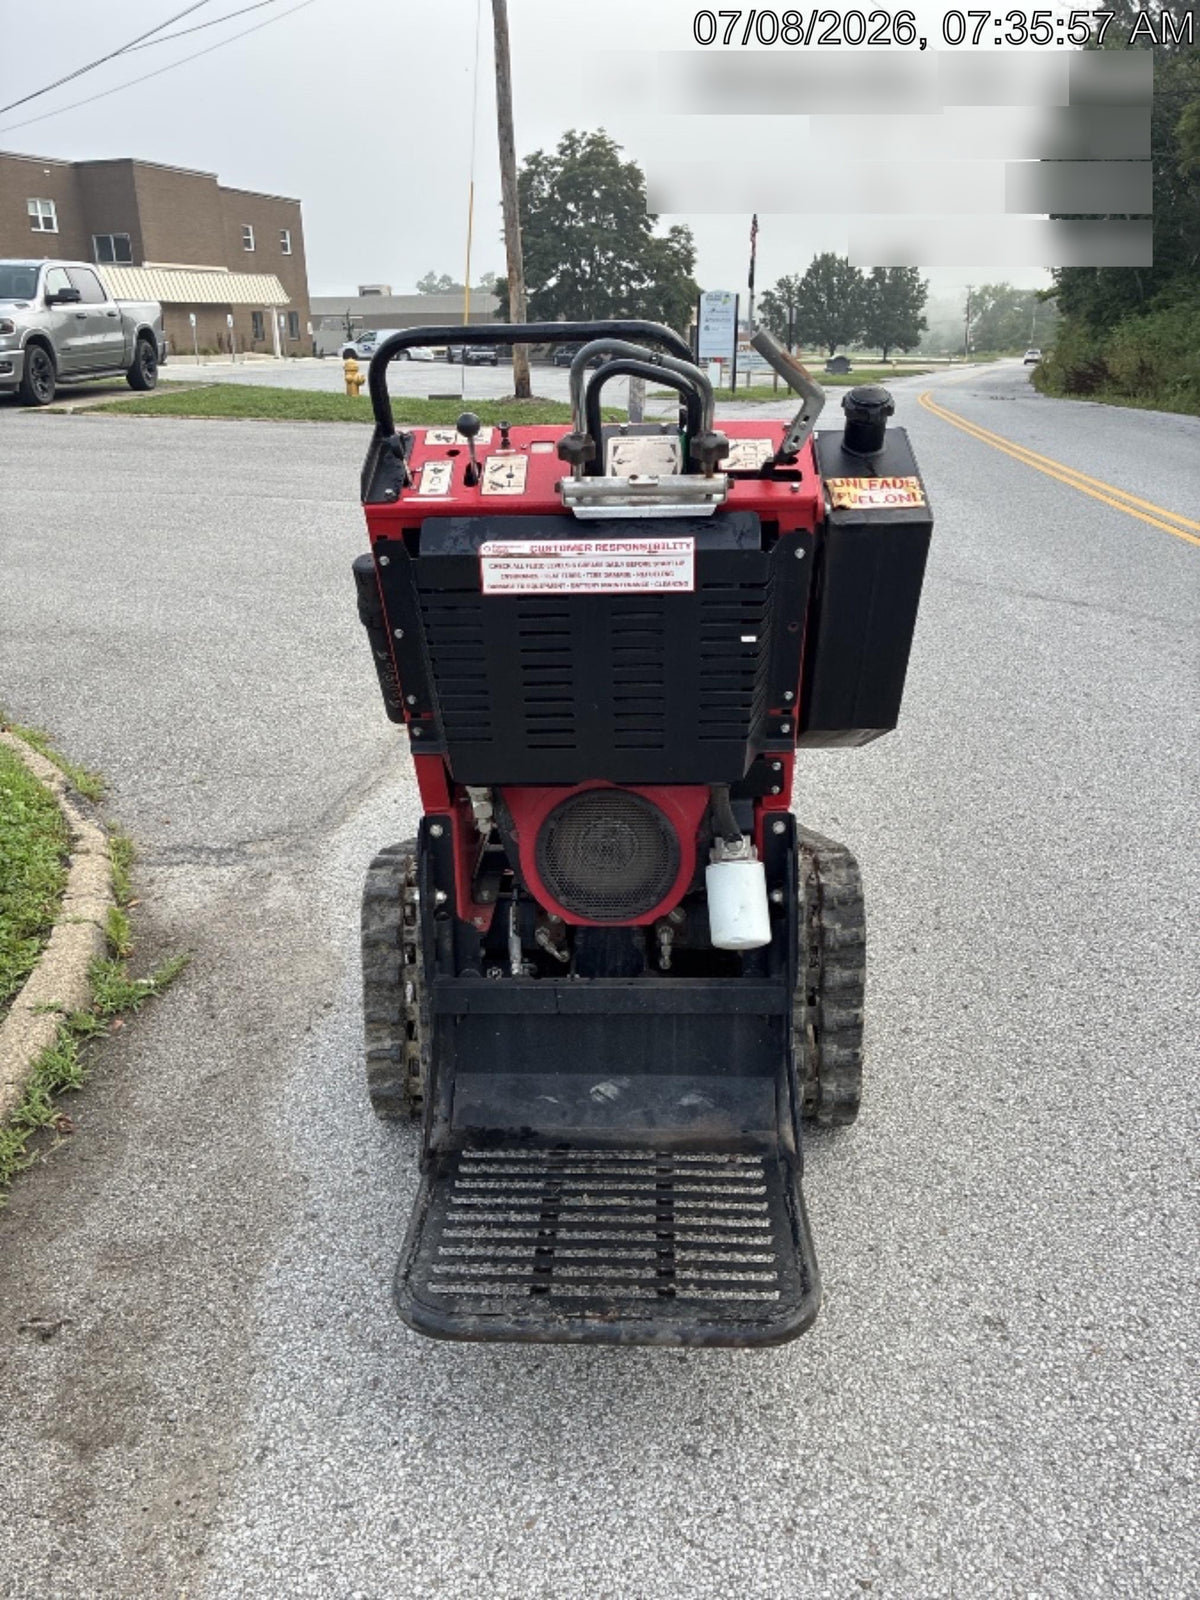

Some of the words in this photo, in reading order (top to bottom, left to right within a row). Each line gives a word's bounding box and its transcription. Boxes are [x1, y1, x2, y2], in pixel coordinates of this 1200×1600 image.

[832, 478, 919, 490] UNLEADE
[530, 543, 592, 554] CUSTOMER
[595, 541, 692, 552] RESPONSIBILITY
